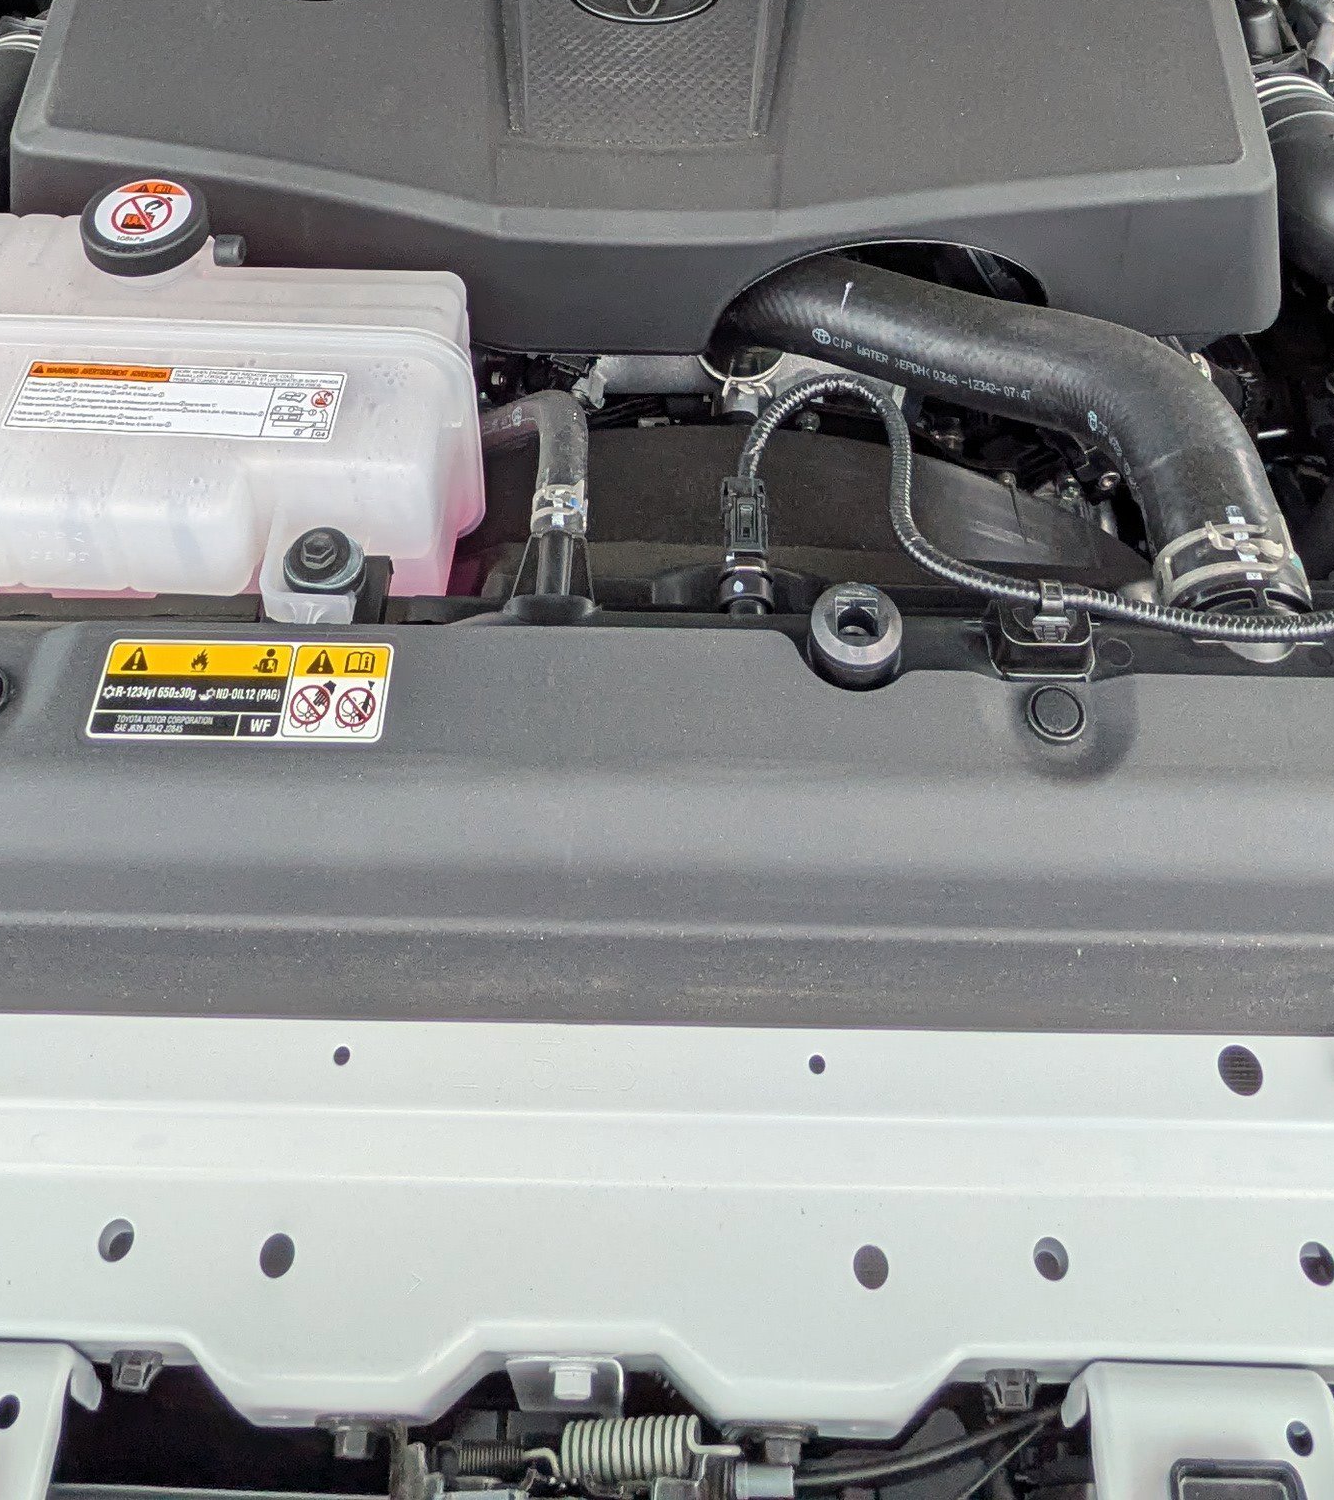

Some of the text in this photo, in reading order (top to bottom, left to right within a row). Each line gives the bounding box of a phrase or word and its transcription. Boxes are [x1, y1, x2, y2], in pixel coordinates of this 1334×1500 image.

[857, 346, 889, 363] WATER
[46, 366, 80, 375] WARNING
[115, 686, 157, 700] R-1234yf
[157, 686, 197, 701] 650±30g
[256, 689, 281, 702] (PAG)
[117, 714, 214, 725] TOYOTA MOTOR CORPORATION
[250, 718, 272, 732] WF
[113, 723, 127, 732] SAE
[127, 724, 144, 733] J639
